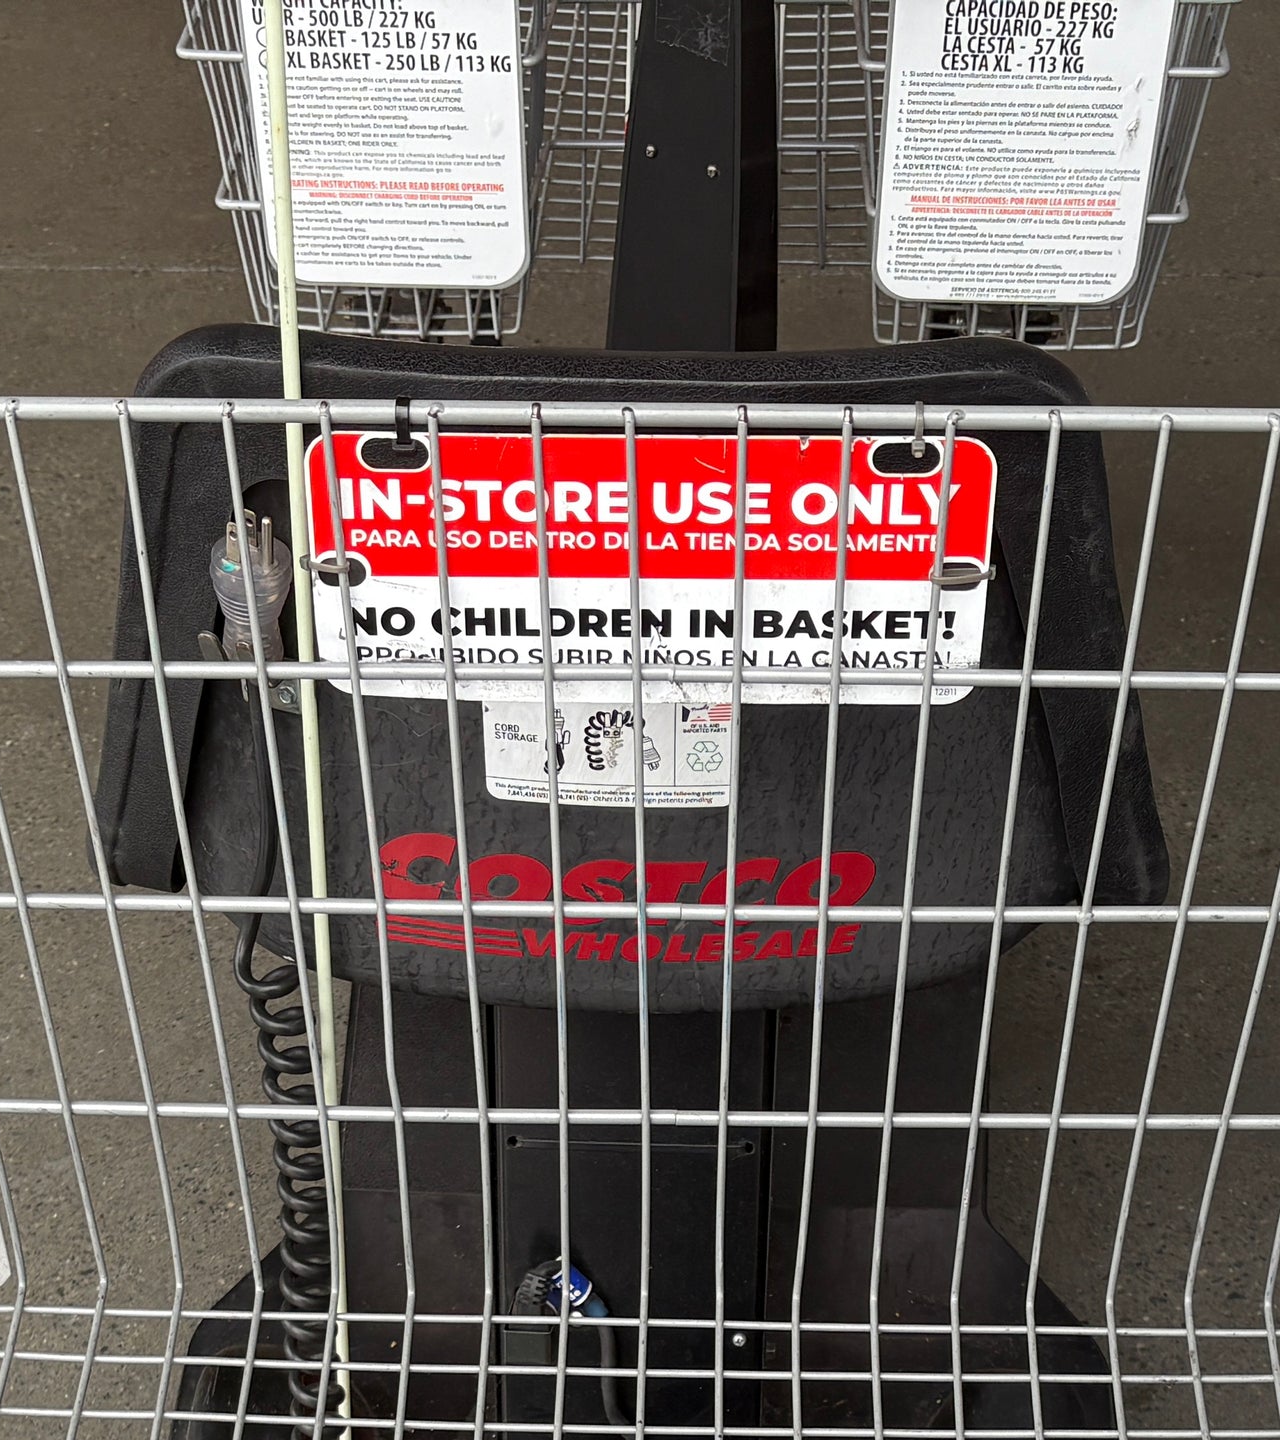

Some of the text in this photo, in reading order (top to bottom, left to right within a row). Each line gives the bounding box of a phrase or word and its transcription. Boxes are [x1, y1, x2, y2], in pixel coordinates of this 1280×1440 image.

[309, 11, 436, 29] 500 LB 227 KG
[945, 0, 1118, 21] CAPACIDAD DE PESO:
[944, 18, 1115, 39] EL USUARIO 227 KG
[285, 29, 477, 50] BASKET 125 LB 57 KG
[942, 35, 1081, 56] LA CESTA 57 KG
[287, 52, 512, 73] XL BASKET 250 LB 113 KG
[941, 54, 1084, 74] CESTA XL 113 KG
[903, 163, 963, 171] ADVERTENCIA:
[338, 478, 962, 525] IN-STORE USE ONLY
[350, 529, 938, 552] PARA USO DENTRO LA TIENDA SOLAMENTE
[351, 606, 957, 640] NO CHILDREN IN BASKET!
[528, 649, 610, 665] SUBIR
[722, 650, 757, 667] EN
[769, 650, 802, 667] LA
[934, 688, 957, 696] 12811
[494, 723, 520, 733] CORD
[494, 731, 539, 743] STORAGE
[377, 833, 876, 927] COSTCO
[521, 923, 862, 963] WHOLESALE
